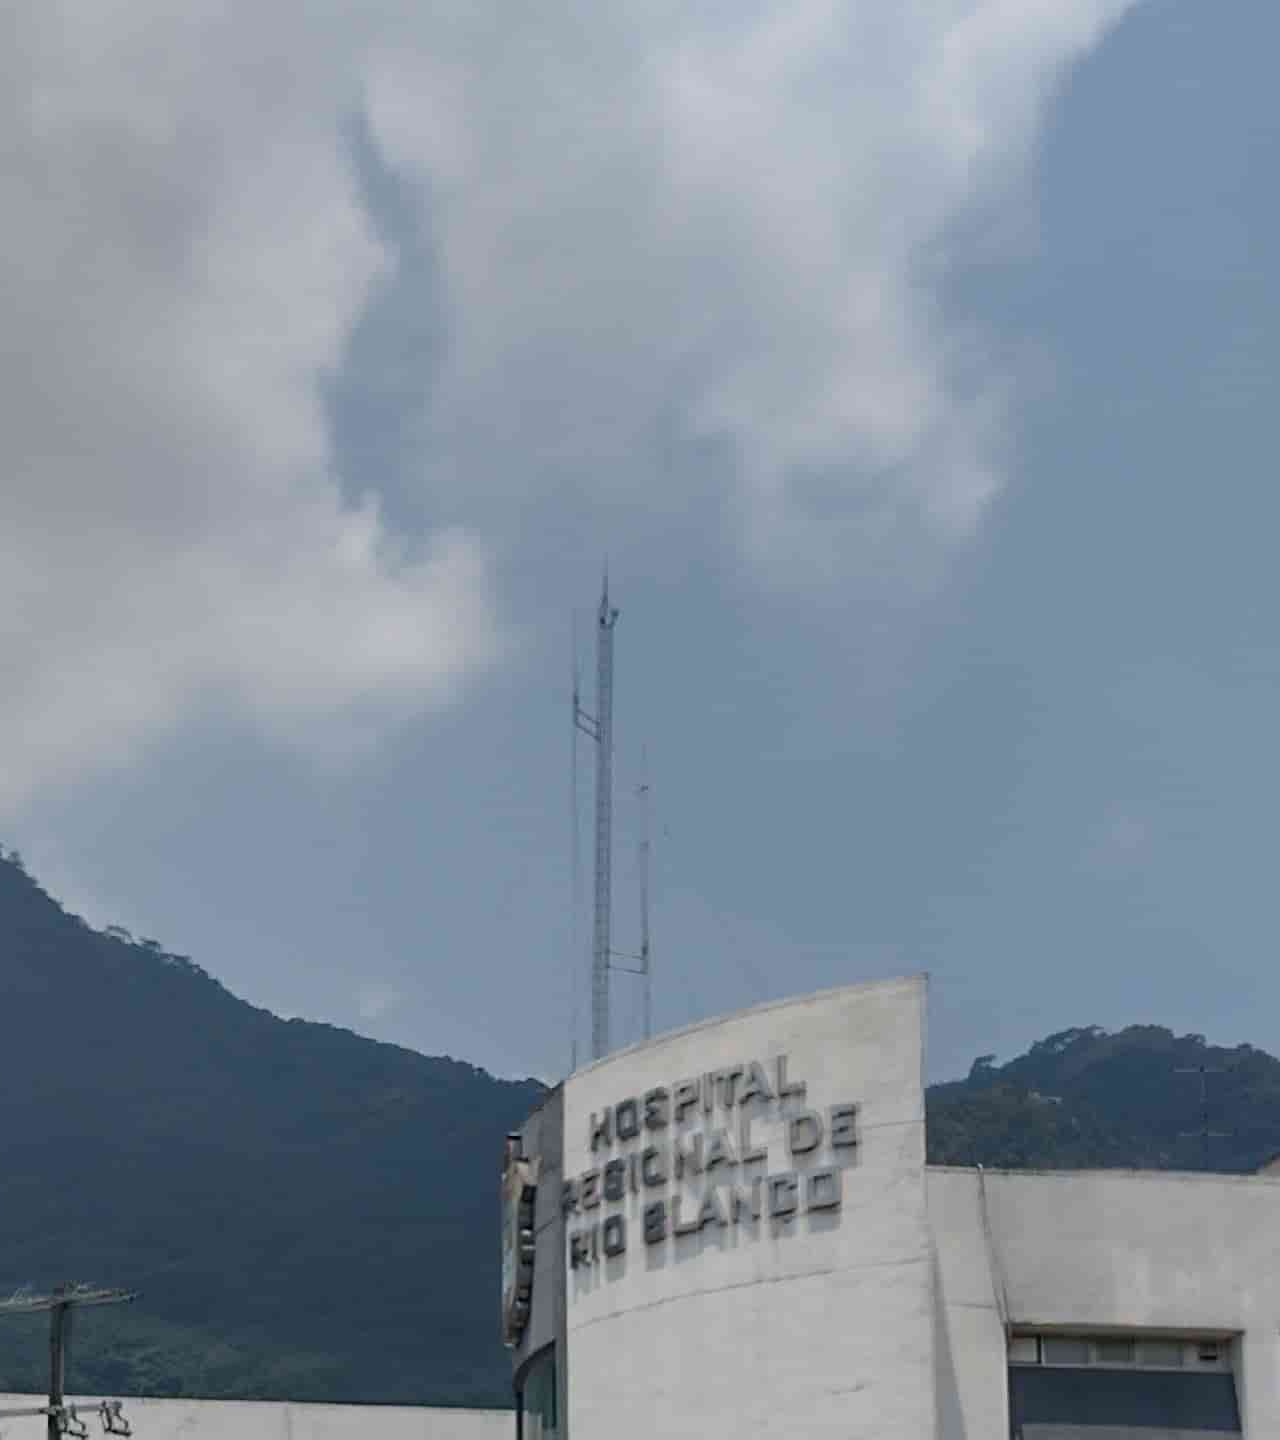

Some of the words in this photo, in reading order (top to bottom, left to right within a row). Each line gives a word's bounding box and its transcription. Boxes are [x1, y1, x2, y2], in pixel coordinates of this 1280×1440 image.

[590, 1055, 807, 1152] HOSPITAL
[563, 1118, 768, 1214] REGIONAL
[789, 1104, 858, 1155] DE
[570, 1214, 626, 1270] RIO
[644, 1172, 842, 1246] BLANCO
